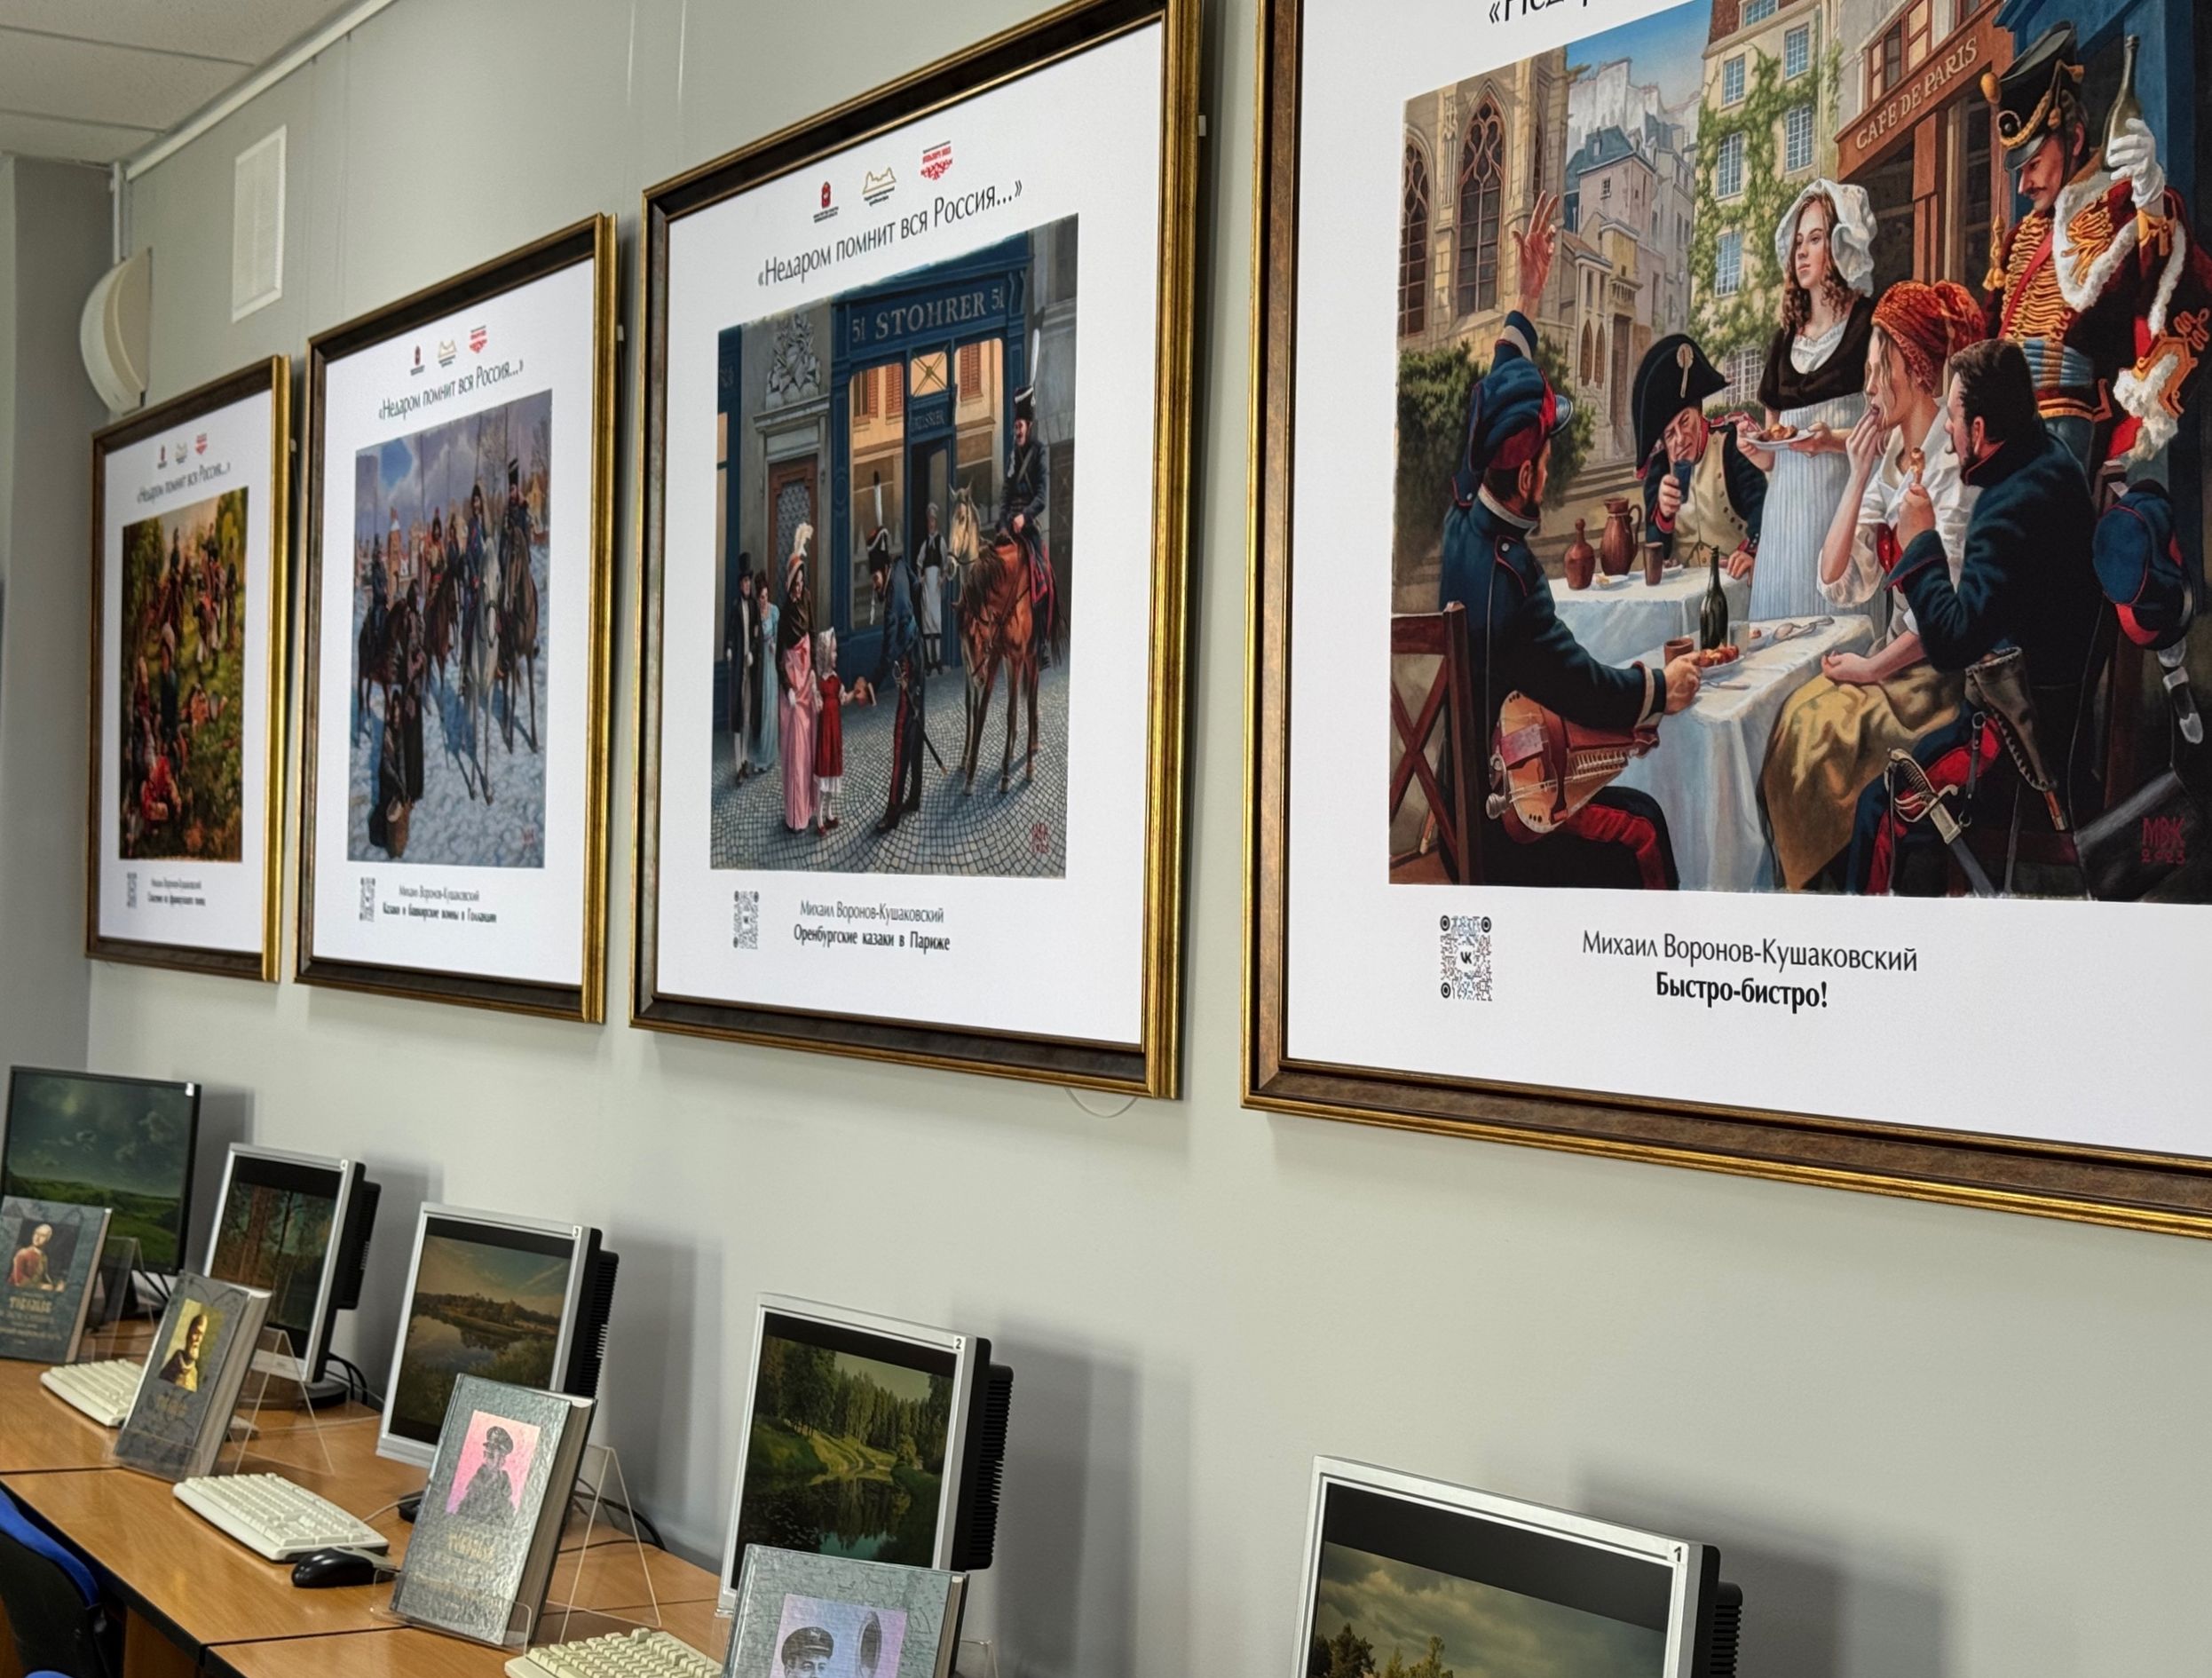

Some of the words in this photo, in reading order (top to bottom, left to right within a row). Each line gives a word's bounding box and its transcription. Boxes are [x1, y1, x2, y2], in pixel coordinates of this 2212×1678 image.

[1856, 102, 1898, 149] CAFE
[1900, 83, 1922, 118] DE
[1924, 36, 1978, 98] PARIS
[758, 245, 832, 286] «Недаром
[837, 222, 896, 262] помнит
[901, 210, 928, 239] вся
[935, 179, 1023, 227] Россия...»
[852, 317, 866, 343] 51
[875, 291, 986, 340] STOHRER
[800, 899, 834, 919] Михаил
[836, 900, 944, 926] Воронов-Кушаковский
[794, 923, 858, 948] Оренбургские
[862, 930, 895, 946] казаки
[898, 935, 905, 947] в
[910, 930, 951, 955] Париже
[1583, 930, 1658, 958] Михаил
[1664, 932, 1917, 974] Воронов-Кушаковский
[1656, 971, 1828, 1015] Быстро-бистро!
[955, 1337, 962, 1350] 2
[1674, 1546, 1682, 1563] 1
